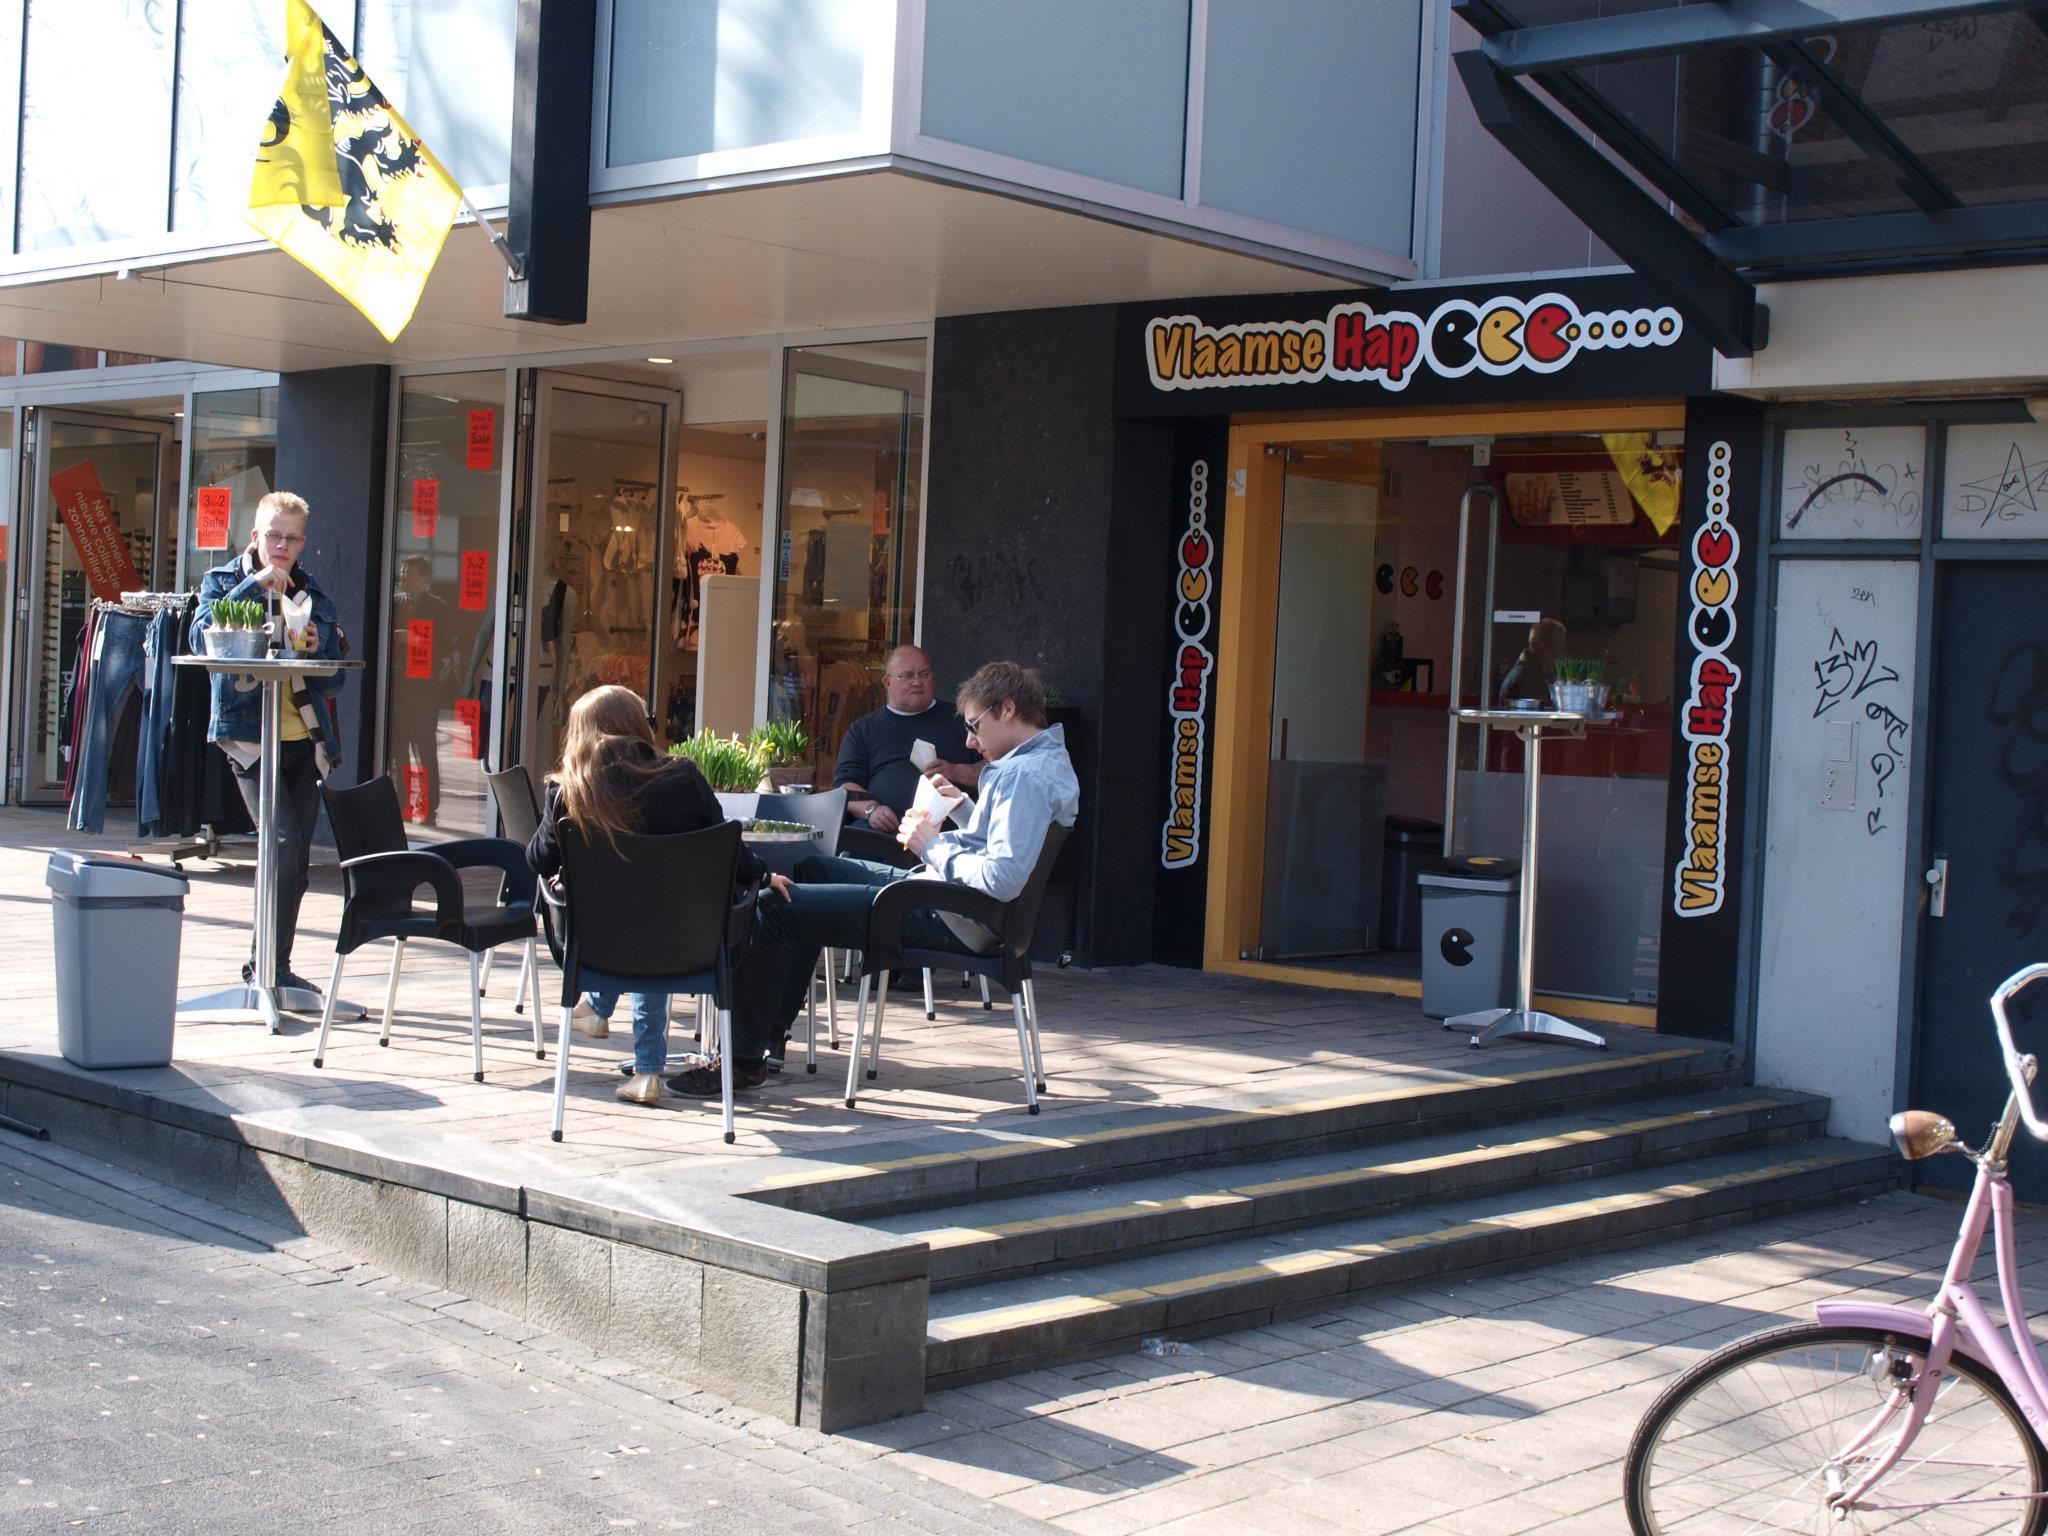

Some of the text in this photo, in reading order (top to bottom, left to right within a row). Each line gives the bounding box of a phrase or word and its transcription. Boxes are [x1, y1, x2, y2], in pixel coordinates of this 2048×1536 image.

[1153, 312, 1419, 381] Vlaamse Hap
[471, 432, 491, 445] Sale
[92, 499, 107, 524] Net
[203, 516, 225, 528] Sale
[67, 505, 108, 586] zonnebrillen!
[74, 491, 120, 590] nieuwe collectie
[465, 577, 483, 589] Sale
[411, 646, 428, 657] Sale
[1166, 645, 1208, 862] Vlaamse Hap
[1680, 659, 1736, 911] Vlaamse Hap
